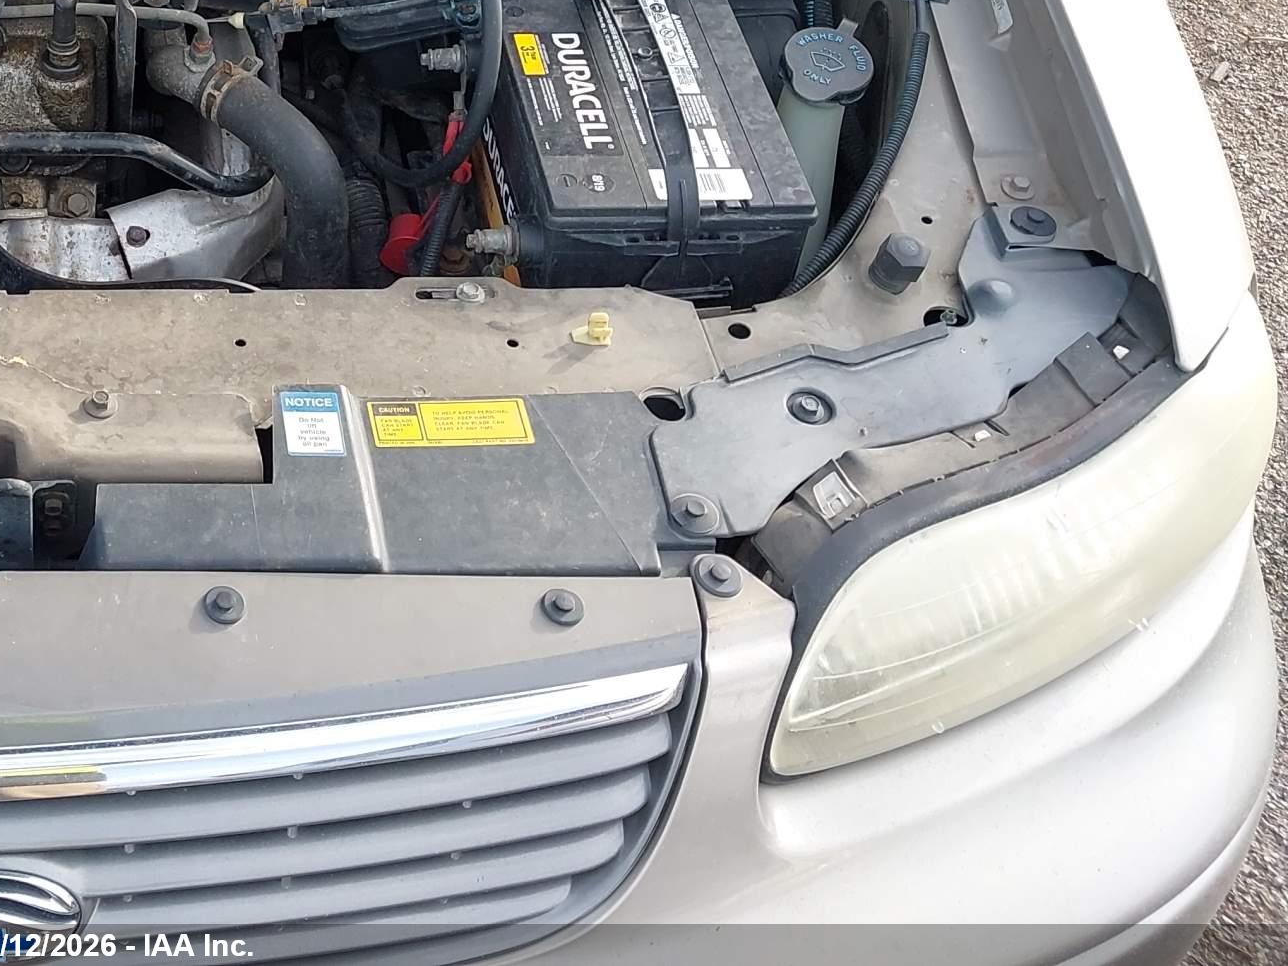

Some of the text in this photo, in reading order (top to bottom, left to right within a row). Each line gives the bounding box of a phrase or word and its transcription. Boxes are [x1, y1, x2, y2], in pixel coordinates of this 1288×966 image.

[520, 45, 529, 53] 3
[796, 33, 867, 72] WASHER FLUID
[803, 68, 832, 86] ONLY
[551, 33, 613, 150] DURACELL
[285, 397, 334, 408] NOTICE
